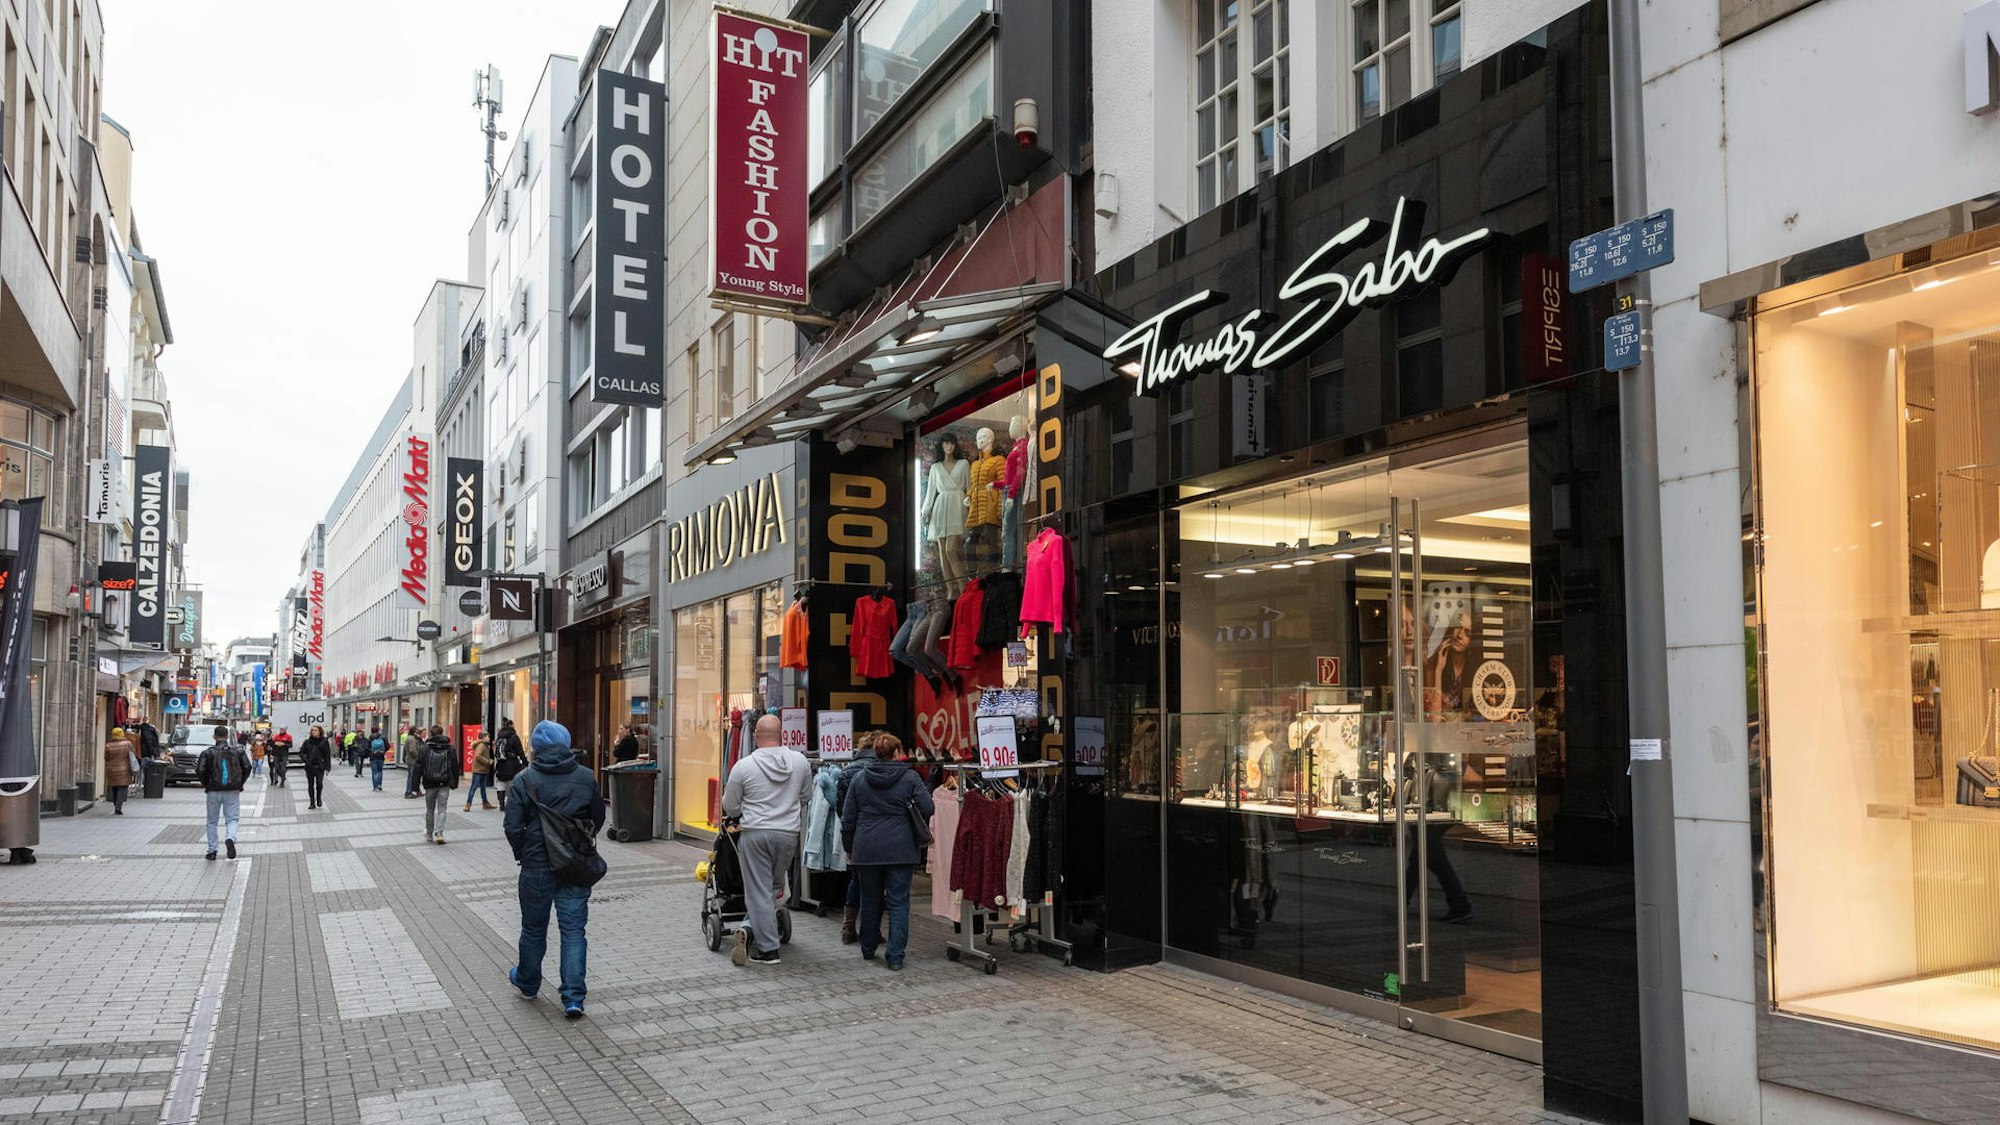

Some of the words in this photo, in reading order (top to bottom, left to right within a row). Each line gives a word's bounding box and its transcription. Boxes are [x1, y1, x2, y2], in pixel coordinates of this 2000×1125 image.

[722, 27, 802, 78] HIT
[744, 79, 778, 271] FASHION
[610, 87, 652, 356] HOTEL
[1653, 221, 1667, 232] 150
[1618, 234, 1631, 244] 150
[1584, 245, 1597, 255] 150
[1647, 244, 1662, 255] 11.8
[719, 271, 767, 291] Young
[768, 279, 804, 297] Style
[1103, 289, 1262, 397] Thomas
[1253, 195, 1490, 369] Sabo
[1620, 295, 1632, 310] 31
[1621, 323, 1634, 333] 150
[1624, 333, 1639, 345] 13.3
[1615, 345, 1630, 357] 13.7
[598, 376, 660, 395] CALLAS
[454, 472, 475, 572] GEOX
[668, 472, 787, 585] RIMOWA
[138, 470, 162, 618] CALZEDONIA
[102, 578, 136, 590] size?
[1498, 666, 1513, 688] CLUB
[1475, 694, 1513, 718] GENERAON
[299, 712, 325, 724] dpd
